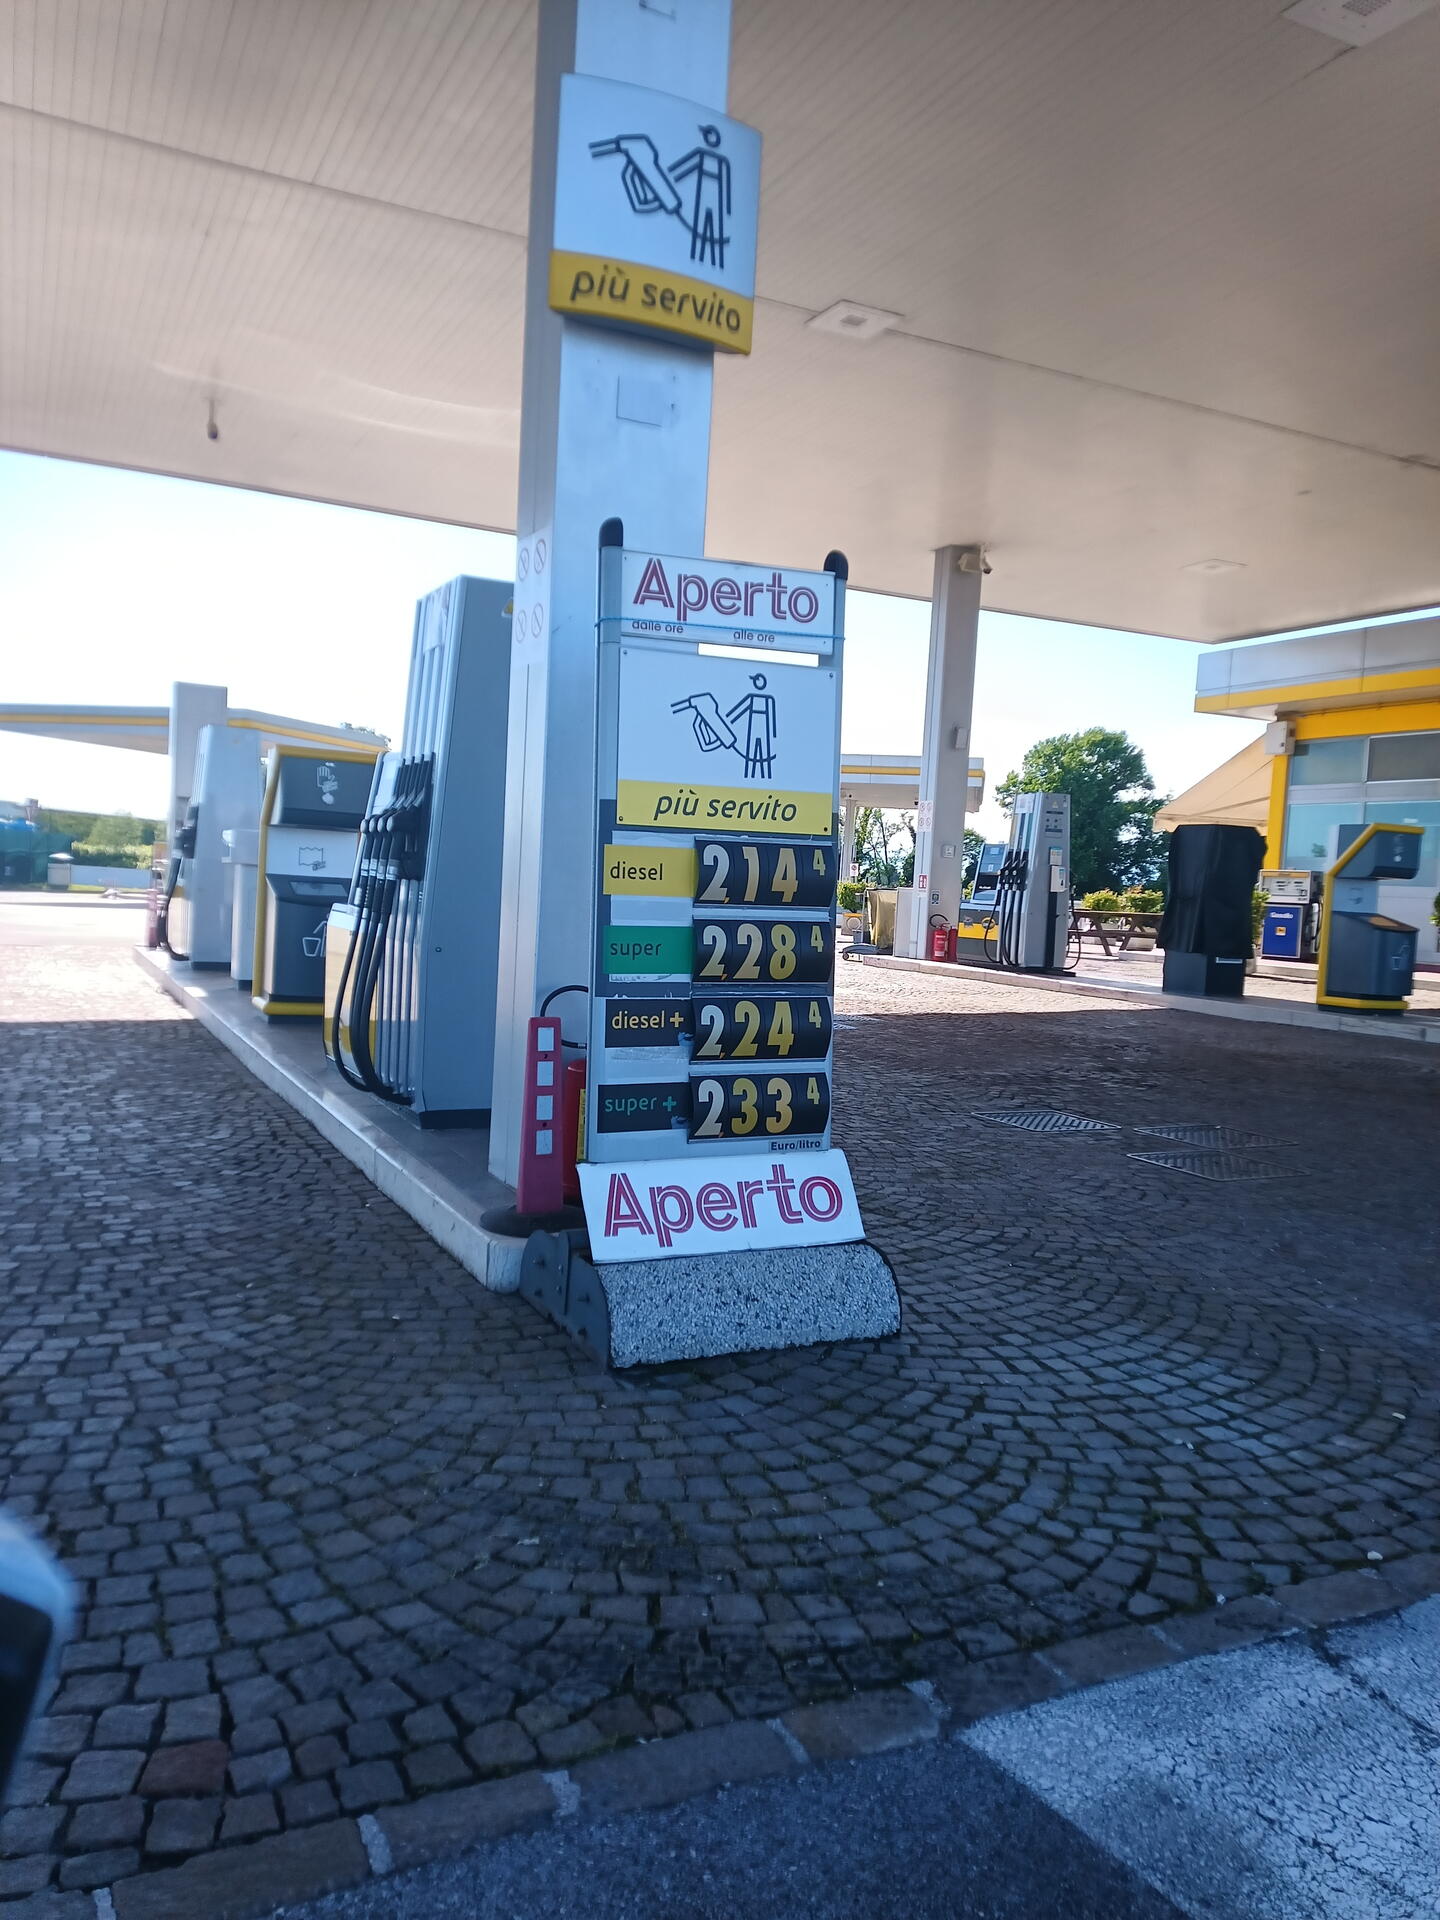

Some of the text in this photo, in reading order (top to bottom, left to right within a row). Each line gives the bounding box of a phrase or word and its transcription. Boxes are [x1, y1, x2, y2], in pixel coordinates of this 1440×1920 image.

[570, 265, 741, 333] più servito
[632, 557, 819, 623] Aperto
[632, 619, 684, 633] dalle ore
[734, 629, 775, 643] alle ore
[654, 788, 797, 822] più servito
[610, 861, 663, 881] diesel
[610, 942, 662, 960] super
[771, 1140, 821, 1151] Euro/litro
[604, 1164, 843, 1248] Aperto
